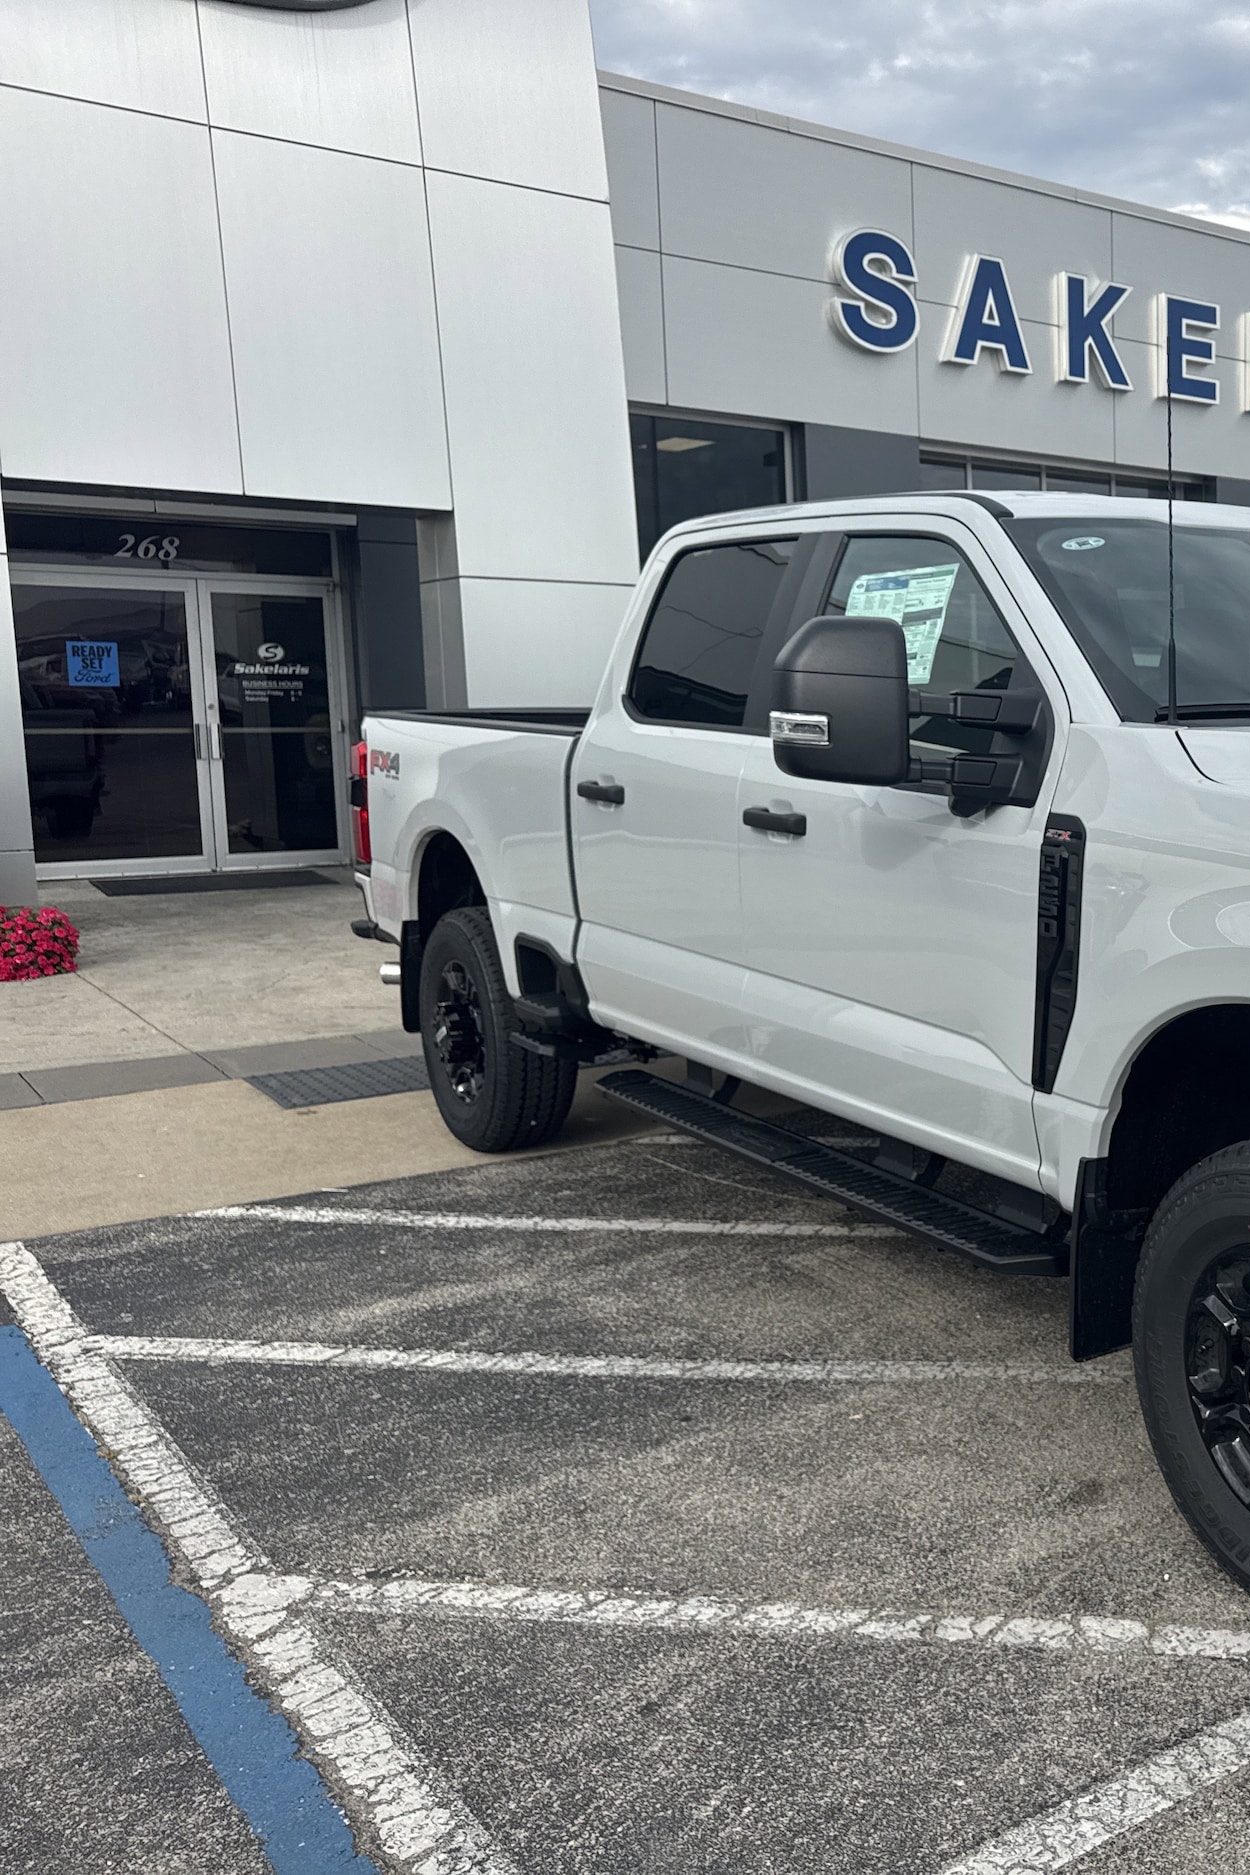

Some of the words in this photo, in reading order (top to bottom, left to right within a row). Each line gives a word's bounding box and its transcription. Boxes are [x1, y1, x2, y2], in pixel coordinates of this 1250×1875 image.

[113, 533, 180, 562] 268
[71, 645, 112, 658] READY
[81, 657, 104, 670] SET
[234, 662, 310, 675] Sakelaris
[74, 669, 112, 683] Ford
[242, 680, 278, 689] BUSINESS
[279, 681, 304, 690] HOURS
[370, 749, 400, 775] FX4
